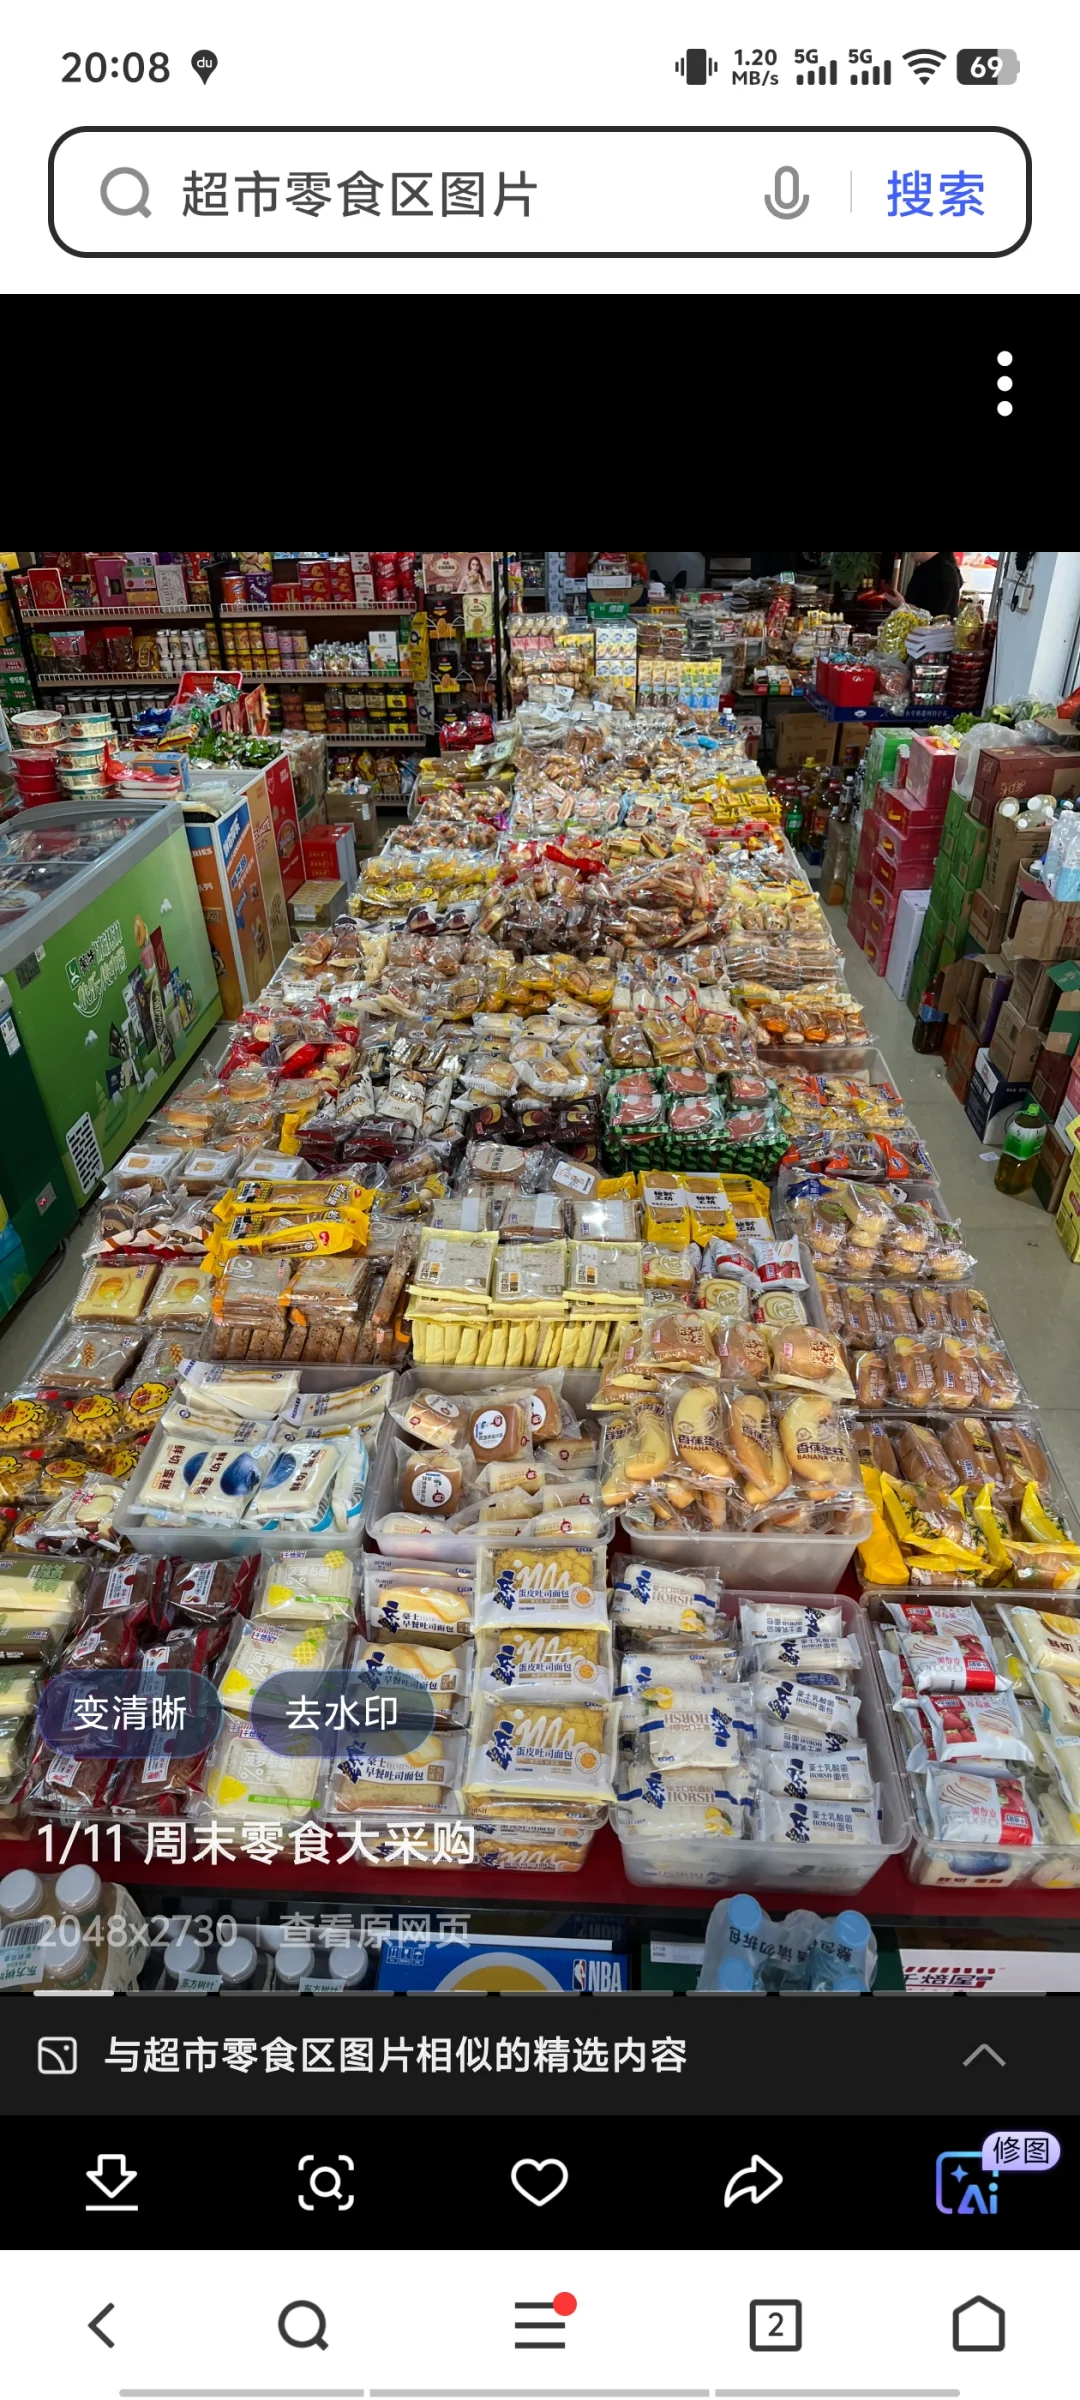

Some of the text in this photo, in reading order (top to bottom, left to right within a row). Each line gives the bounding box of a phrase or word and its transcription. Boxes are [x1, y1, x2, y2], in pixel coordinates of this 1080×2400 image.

[196, 56, 213, 69] du
[734, 49, 778, 66] 1.20
[794, 49, 819, 64] 5G
[848, 49, 873, 64] 5G
[61, 52, 170, 83] 20:08
[970, 57, 1003, 78] 69
[732, 71, 779, 87] MB/s
[182, 170, 538, 218] 超市零食区图片
[887, 170, 985, 218] 搜索
[797, 1443, 845, 1456] 香蕉蛋糕
[797, 1454, 850, 1463] BANANA CAKE
[518, 1589, 570, 1598] 蛋皮吐司面包
[652, 1591, 694, 1606] HORSH
[402, 1612, 420, 1621] 豪士
[766, 1617, 782, 1626] 面包
[402, 1620, 454, 1633] 早餐吐司面包
[518, 1662, 572, 1673] 蛋皮吐司面包
[384, 1674, 438, 1690] 早餐吐司面包
[818, 1703, 834, 1715] 面包
[664, 1712, 709, 1724] HORSH
[516, 1748, 573, 1760] 蛋皮吐司面包
[367, 1756, 386, 1768] 豪士
[808, 1763, 848, 1773] 豪士乳酸菌
[365, 1765, 425, 1782] 早餐吐司面包
[833, 1772, 849, 1781] 面包
[667, 1790, 715, 1804] HORSH
[812, 1811, 853, 1823] 豪士乳酸菌
[836, 1823, 853, 1833] 面包
[588, 1960, 622, 1992] NBA
[181, 1978, 215, 1990] 东方树叶
[104, 2035, 687, 2074] 与超市零食区图片相似的精选内容
[993, 2136, 1049, 2164] 修图
[957, 2184, 998, 2214] Ai
[768, 2311, 784, 2337] 2
